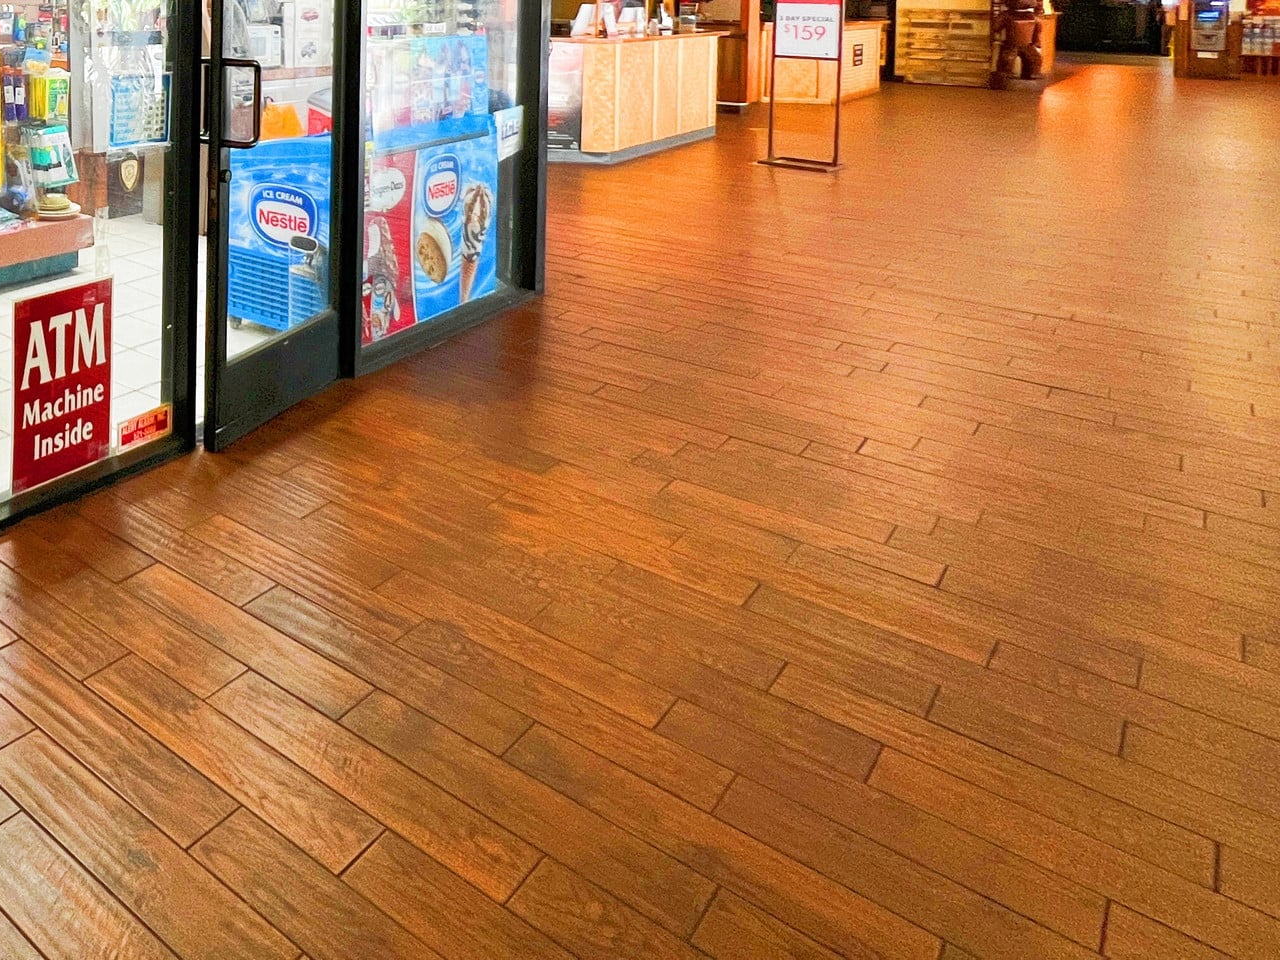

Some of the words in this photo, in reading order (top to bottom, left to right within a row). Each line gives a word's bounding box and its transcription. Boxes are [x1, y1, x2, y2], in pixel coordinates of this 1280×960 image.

[783, 23, 827, 41] $159
[262, 189, 275, 199] ICE
[275, 191, 303, 206] CREAM
[20, 302, 108, 392] ATM
[22, 382, 105, 430] Machine
[33, 417, 94, 461] Inside
